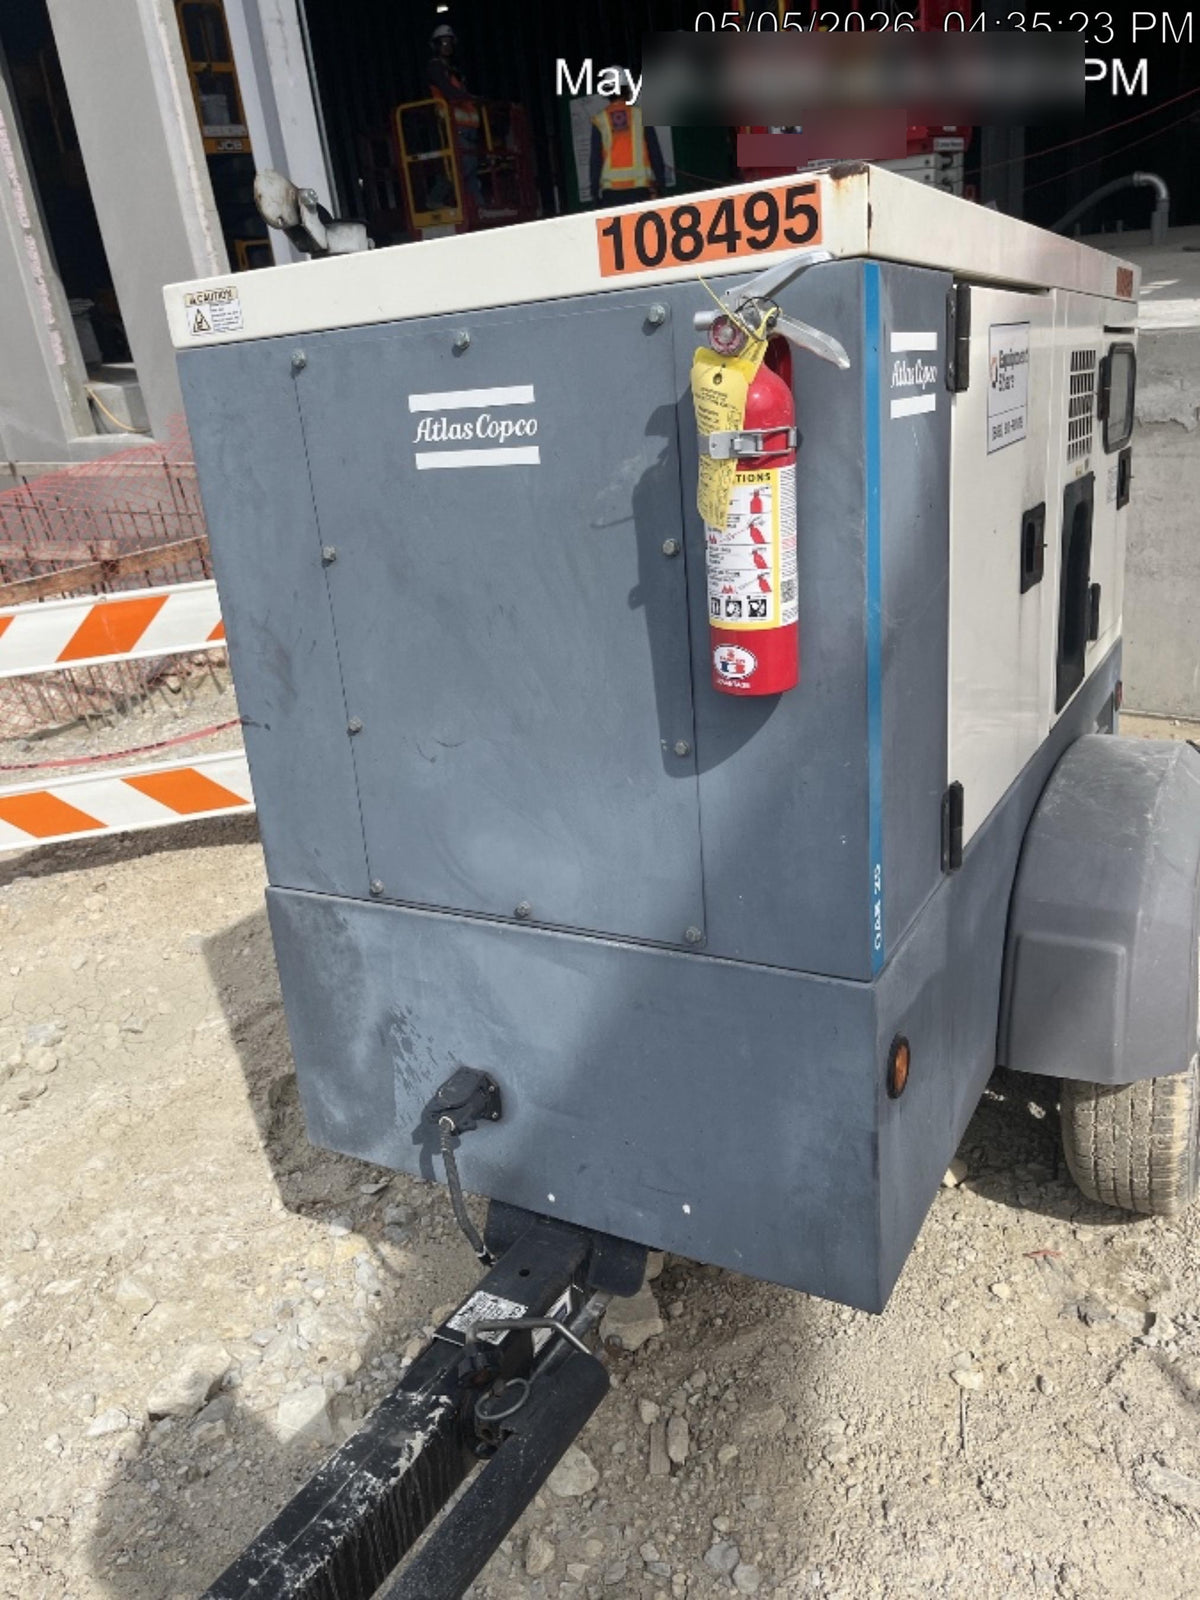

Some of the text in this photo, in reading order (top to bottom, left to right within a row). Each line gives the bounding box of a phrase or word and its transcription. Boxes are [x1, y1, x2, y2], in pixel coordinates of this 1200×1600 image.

[216, 140, 243, 151] JCB
[602, 183, 819, 271] 108495
[196, 288, 233, 304] CAUTION
[998, 348, 1029, 371] Equipment
[890, 358, 938, 390] Atlas Copco
[998, 373, 1015, 391] Share
[412, 413, 538, 444] Atlas Copco
